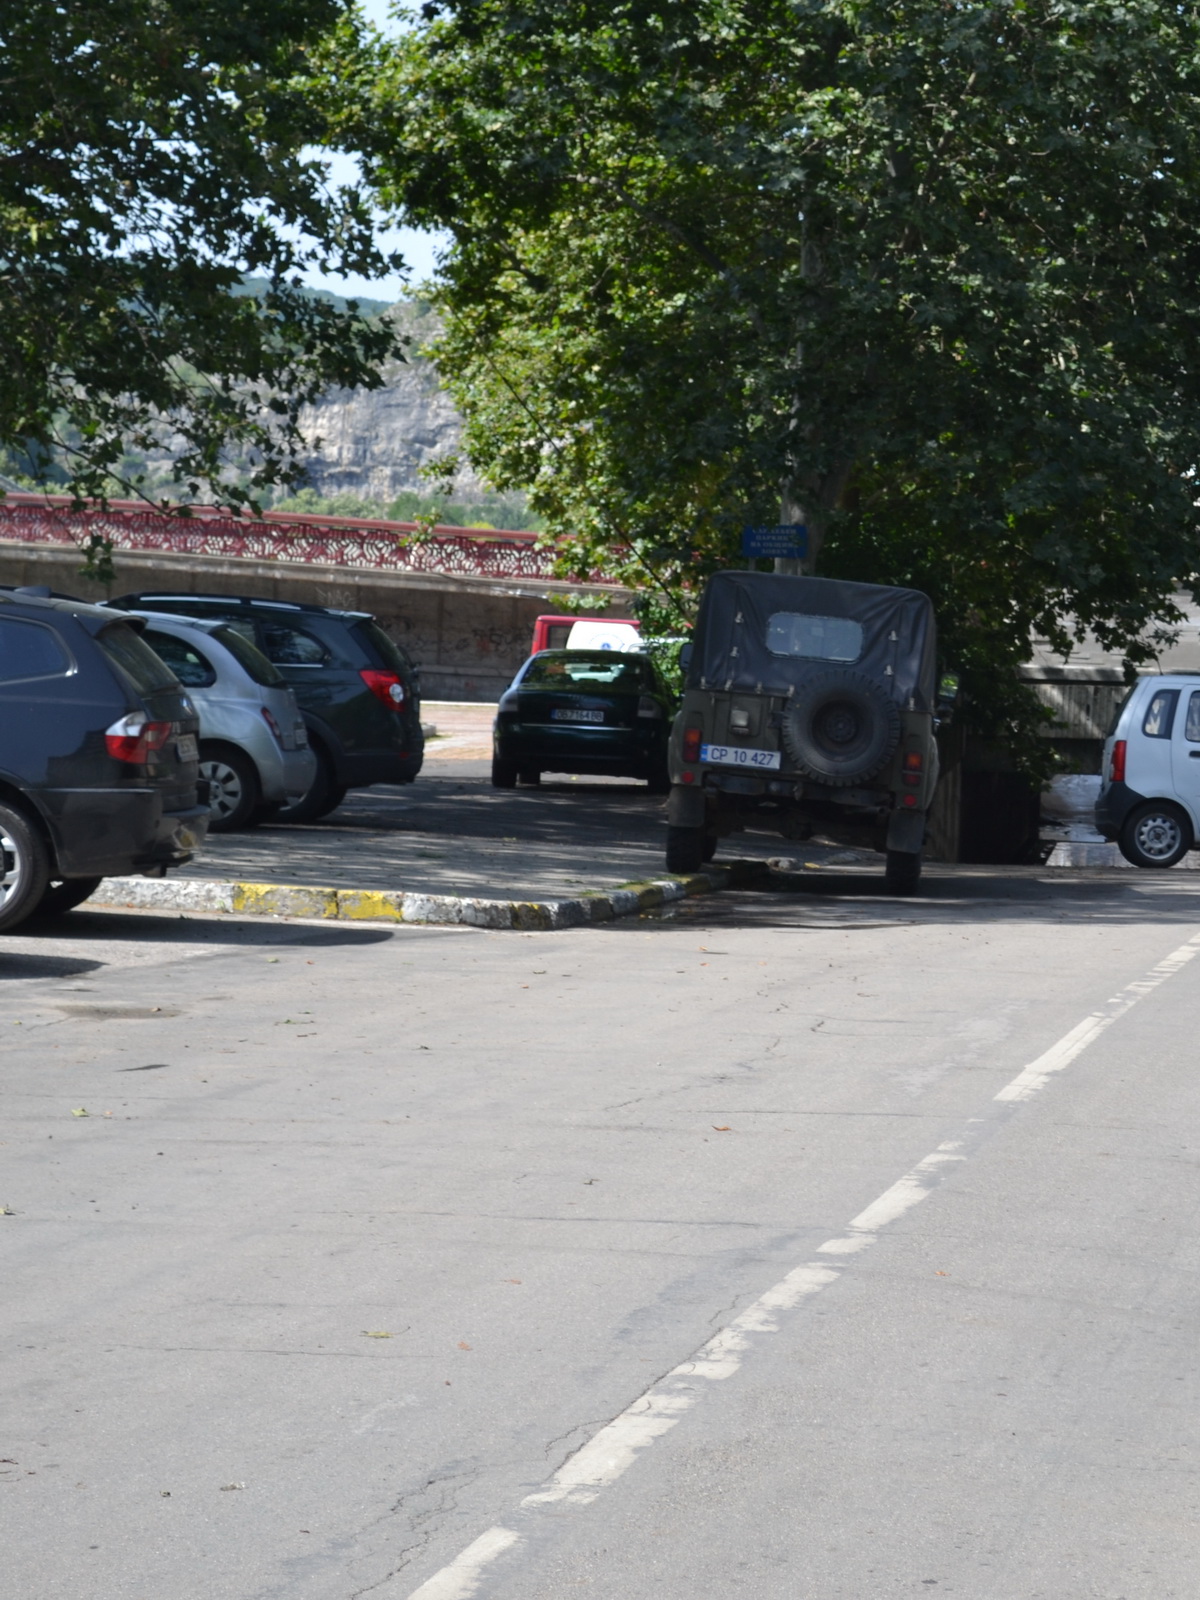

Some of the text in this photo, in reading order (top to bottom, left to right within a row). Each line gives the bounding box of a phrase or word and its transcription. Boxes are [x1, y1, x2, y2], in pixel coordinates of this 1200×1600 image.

[711, 748, 774, 765] CP 10 427
